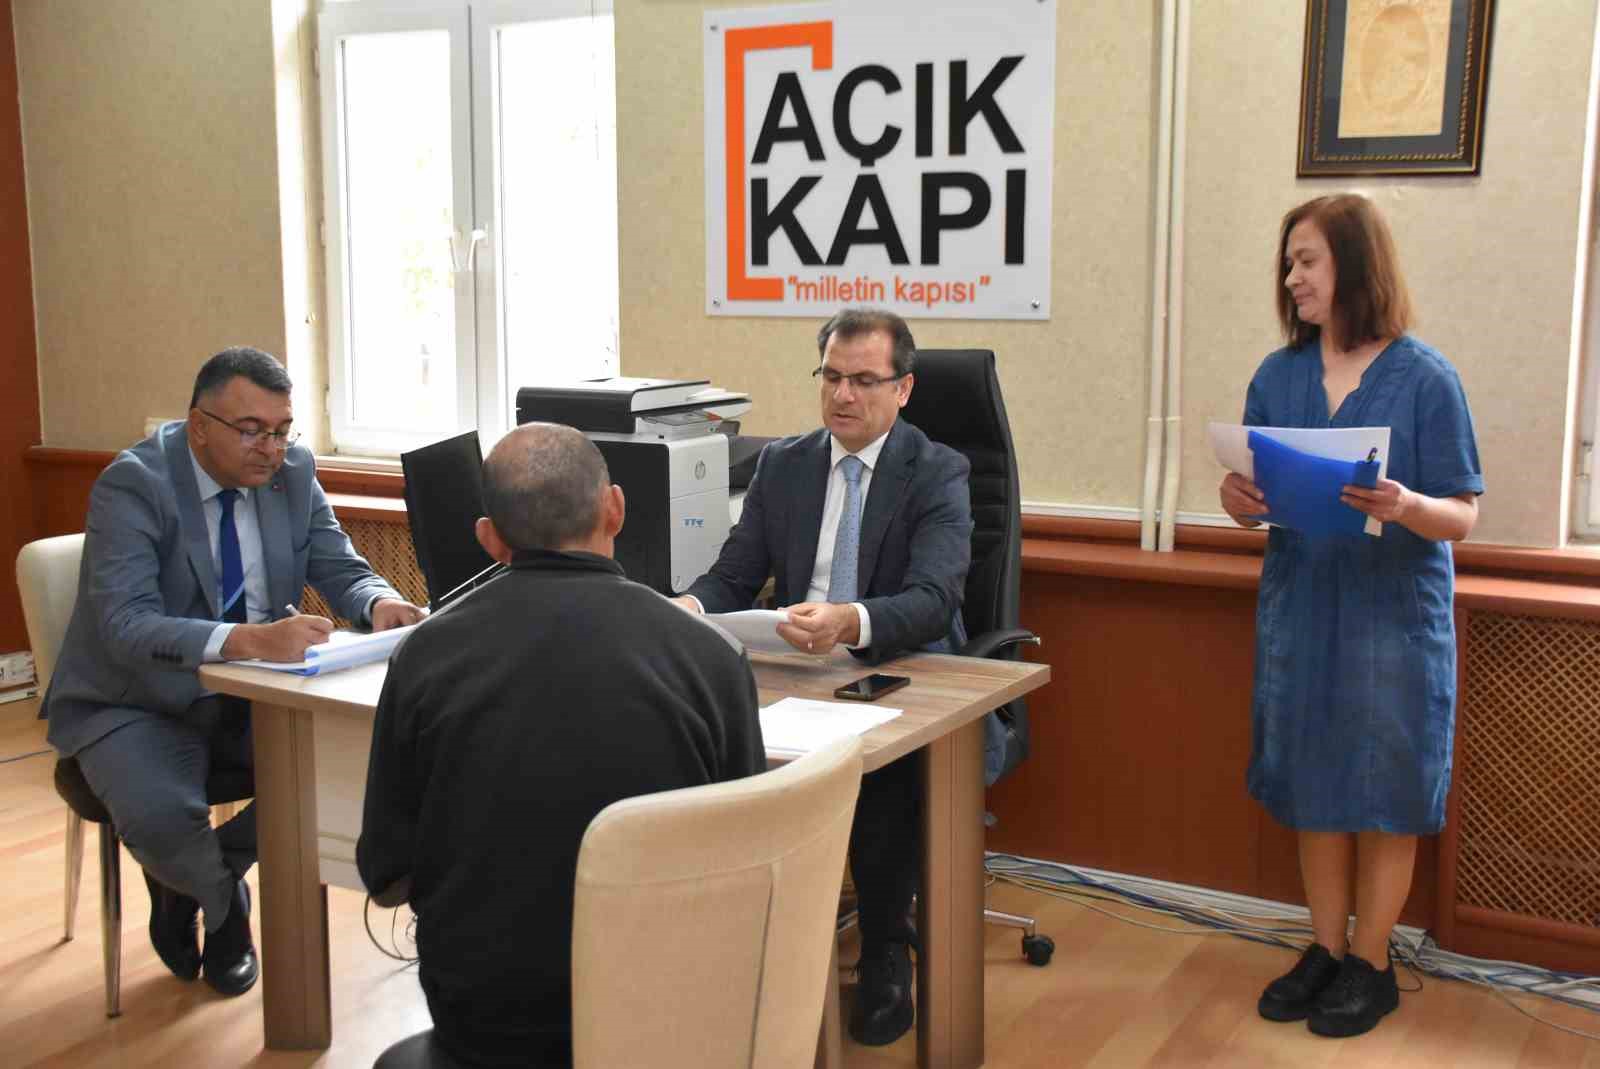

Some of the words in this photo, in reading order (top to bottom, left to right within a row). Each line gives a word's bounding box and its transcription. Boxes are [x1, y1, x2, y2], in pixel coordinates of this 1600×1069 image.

[751, 55, 1026, 167] AÇIK
[750, 169, 1027, 266] KAPI
[788, 275, 885, 302] "milletin
[894, 275, 992, 308] kapısı"
